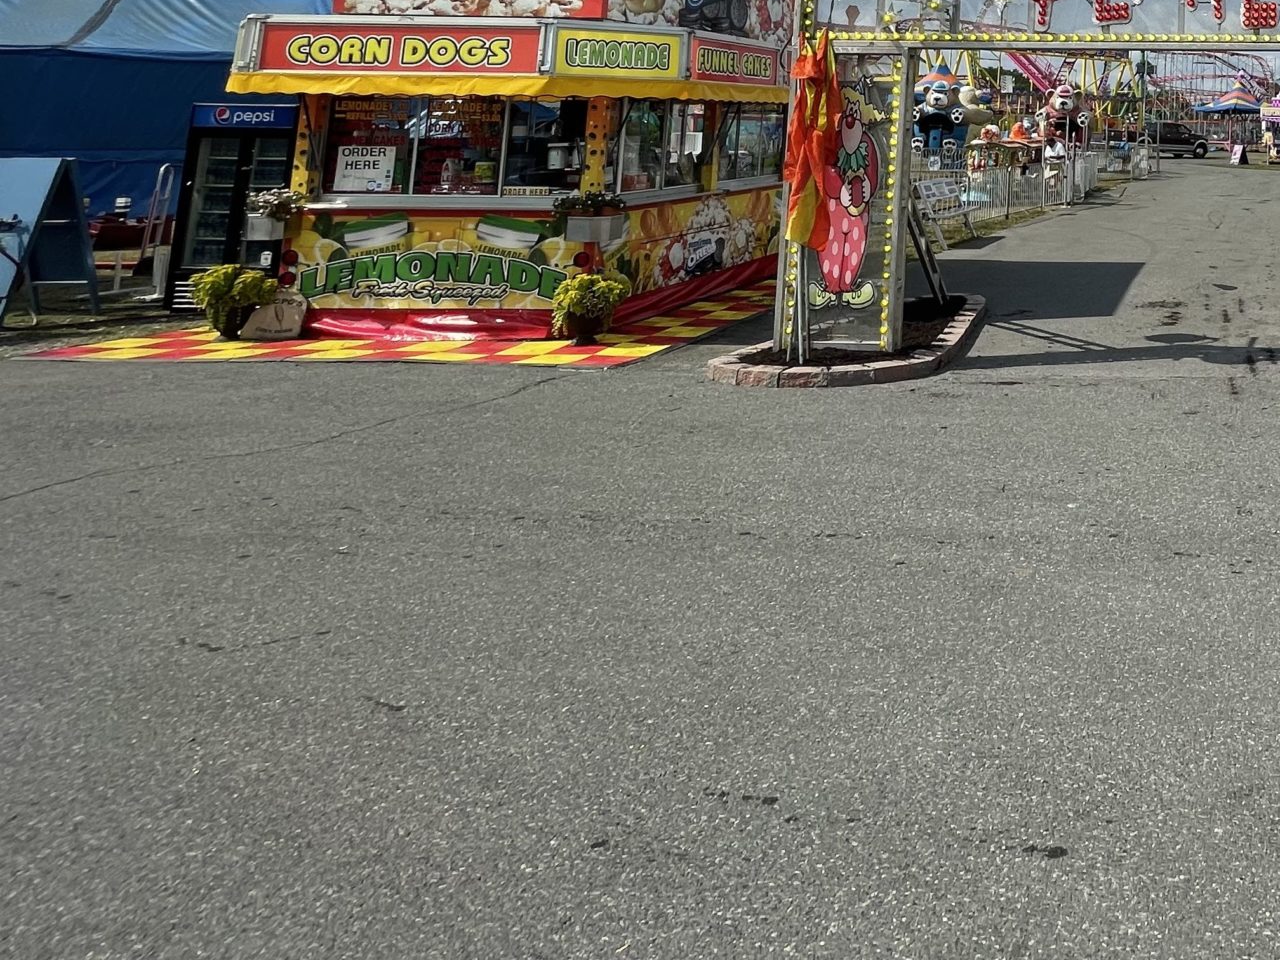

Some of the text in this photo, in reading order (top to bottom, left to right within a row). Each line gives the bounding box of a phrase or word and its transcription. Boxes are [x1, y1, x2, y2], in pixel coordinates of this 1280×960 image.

[287, 35, 512, 68] CORN DOGS
[566, 39, 671, 70] LEMONADE
[697, 47, 773, 78] FUNNEL CAKES
[233, 109, 275, 125] pepsi
[342, 147, 387, 157] ORDER
[345, 160, 380, 170] HERE
[503, 188, 549, 196] ORDER HERE
[354, 243, 402, 258] LEMONADE
[478, 245, 522, 259] LEMONADE
[300, 251, 568, 299] LEMONADE
[411, 282, 508, 306] Squeezed
